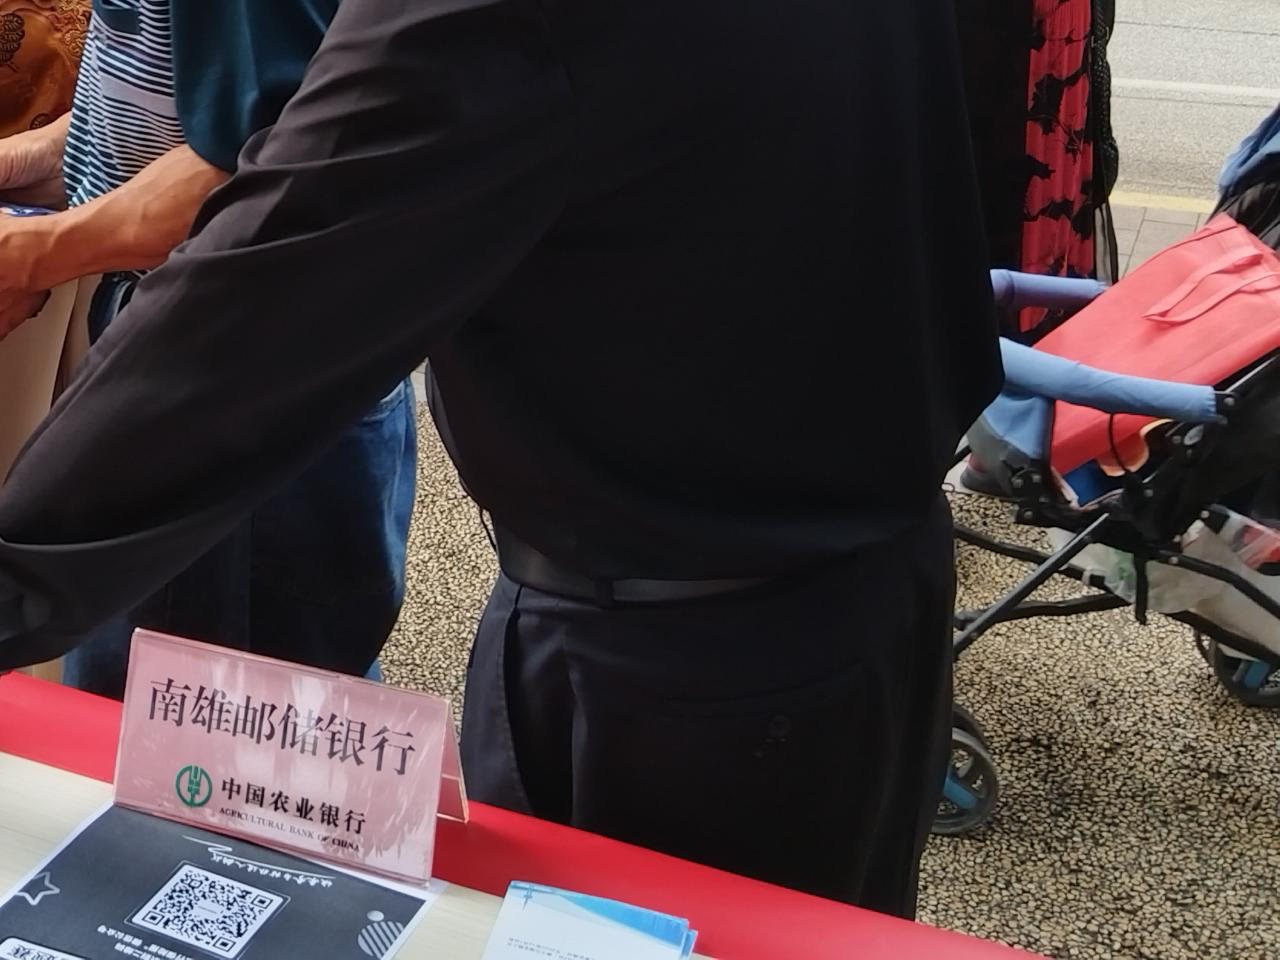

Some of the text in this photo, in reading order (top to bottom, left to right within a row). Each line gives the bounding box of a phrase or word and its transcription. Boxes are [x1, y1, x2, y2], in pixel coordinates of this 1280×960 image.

[149, 678, 416, 776] 南雄邮储银行
[220, 808, 286, 833] AGRICULTURAL
[289, 825, 315, 840] BANK
[331, 837, 360, 852] CHINA
[221, 777, 366, 835] 中国农业银行
